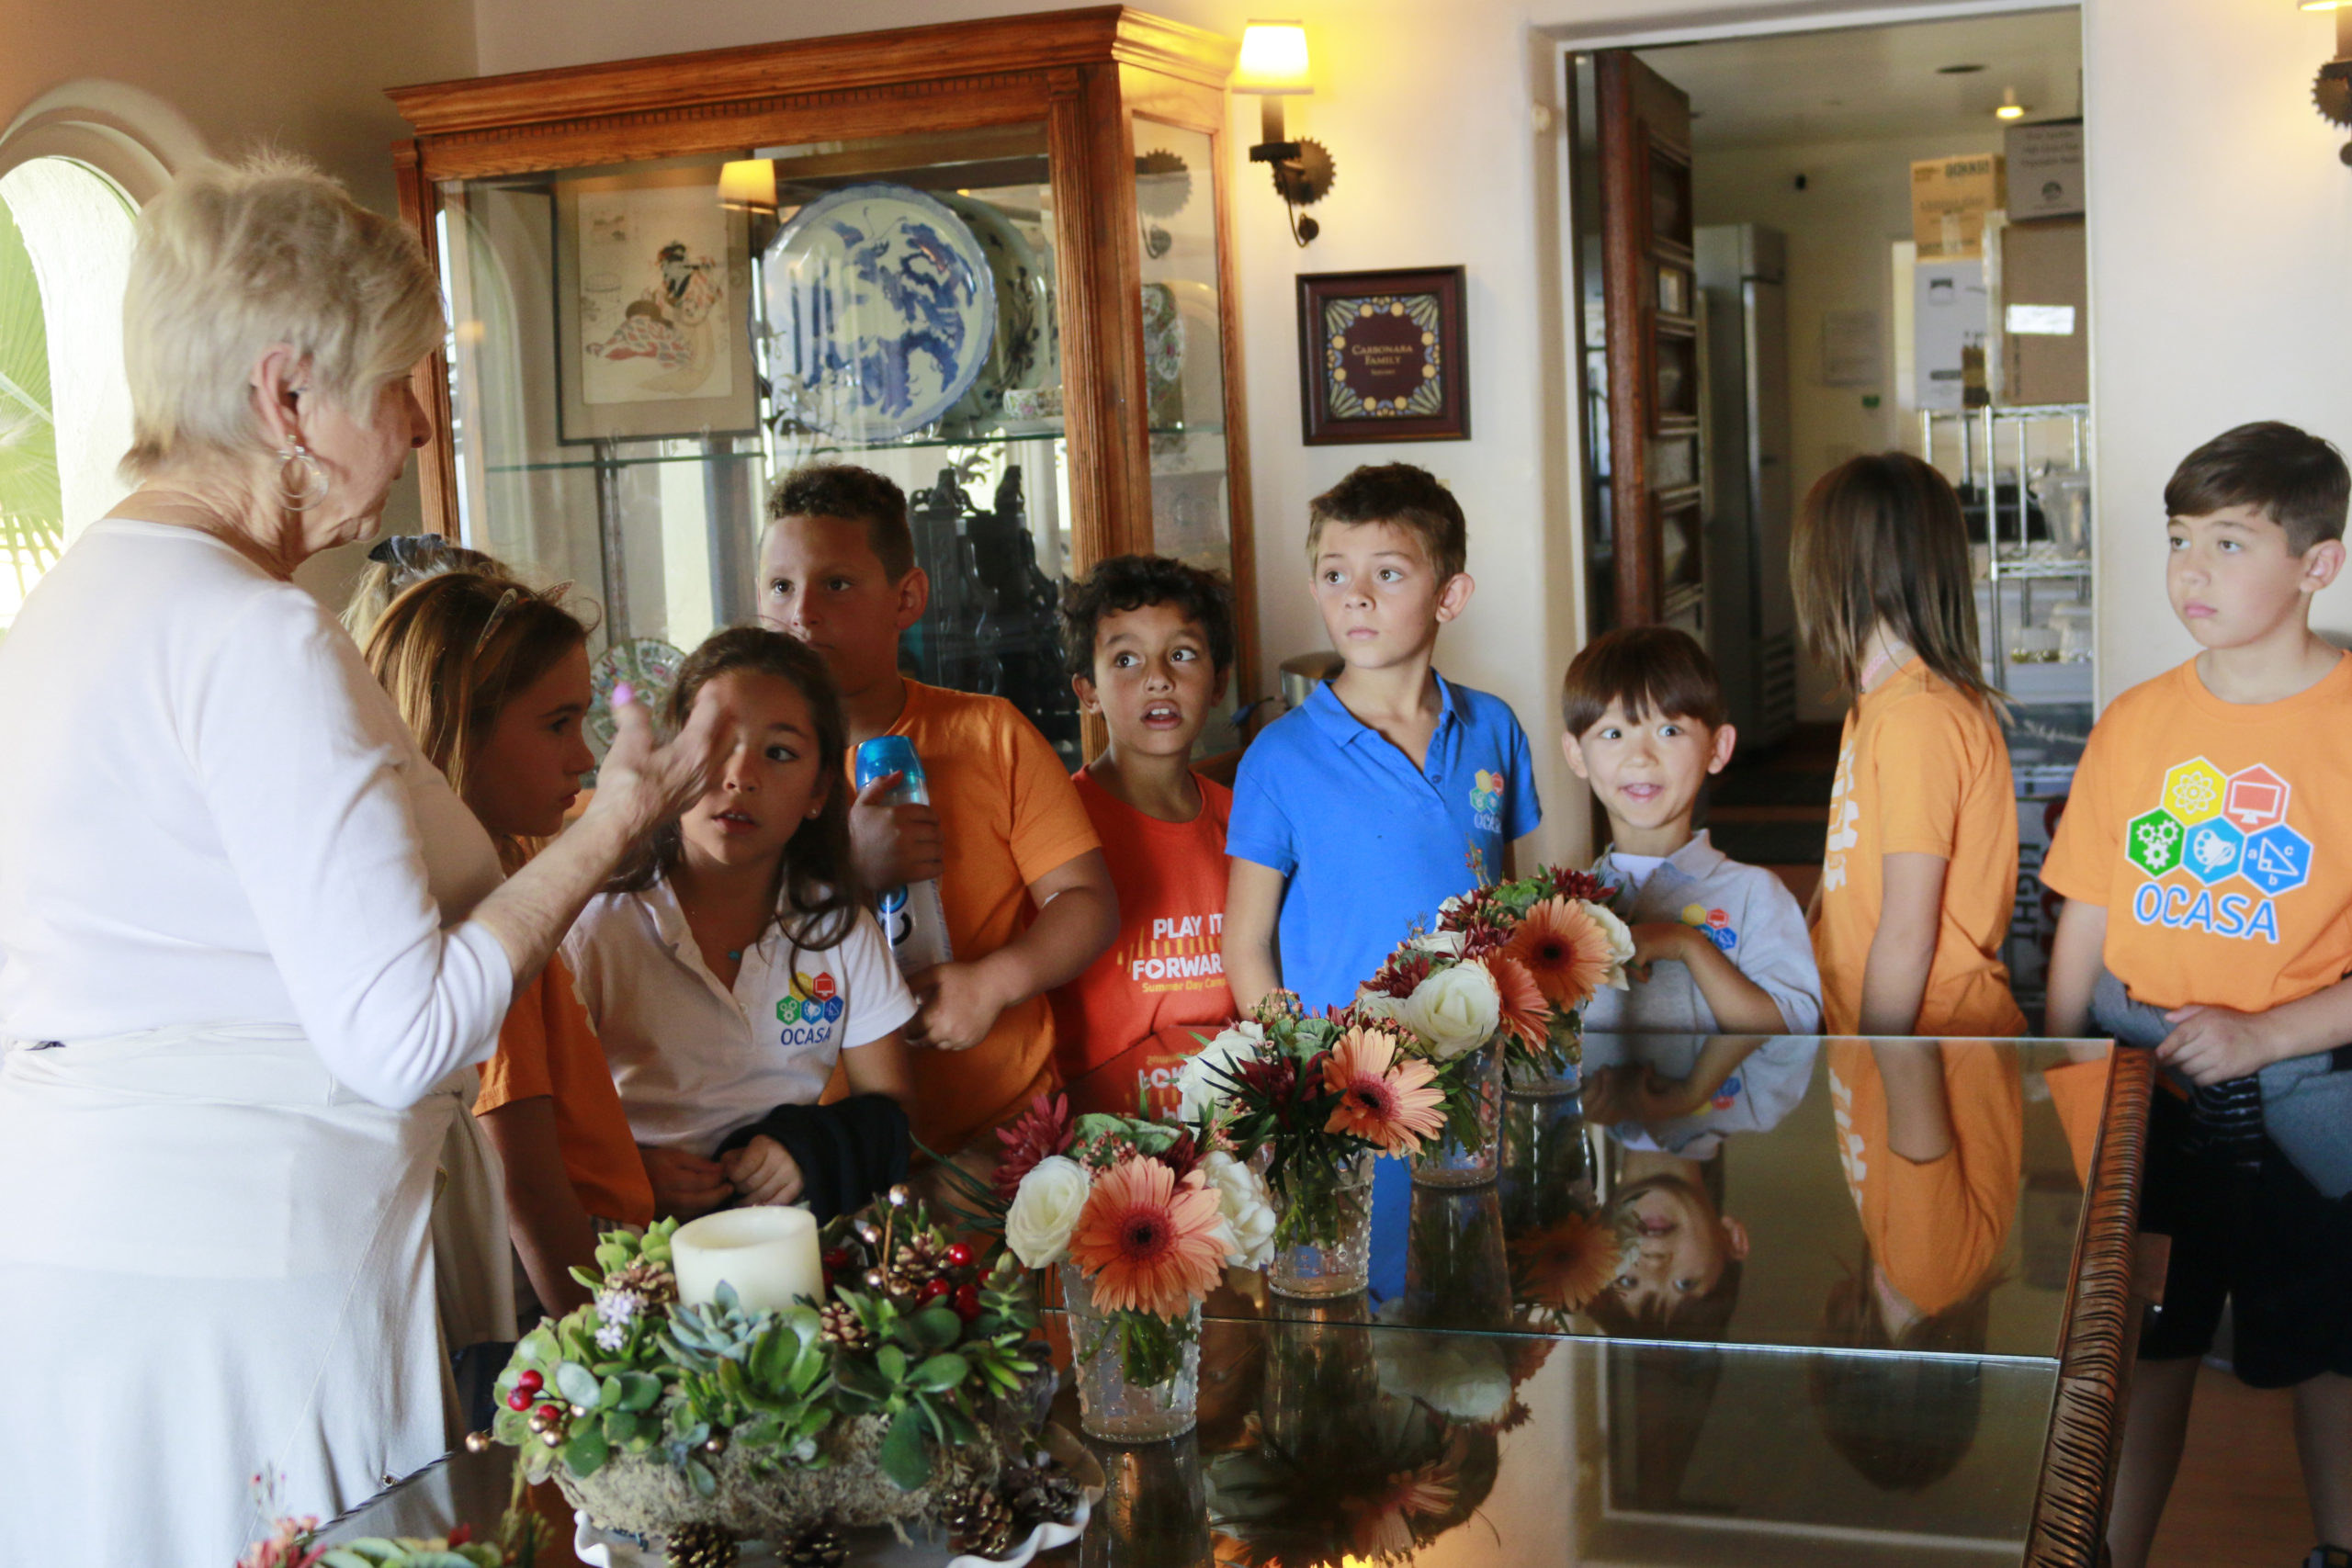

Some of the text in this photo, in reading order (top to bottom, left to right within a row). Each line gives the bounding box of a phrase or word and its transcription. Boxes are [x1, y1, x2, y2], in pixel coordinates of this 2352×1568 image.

[1365, 355, 1401, 366] FAMILY
[2013, 844, 2040, 946] LIGHT
[2133, 882, 2279, 943] OCASA
[1153, 913, 1224, 940] PLAY IT
[1132, 953, 1224, 981] FORWAR
[1142, 982, 1183, 993] Summer
[1185, 979, 1204, 991] Day
[781, 1027, 832, 1045] OCASA
